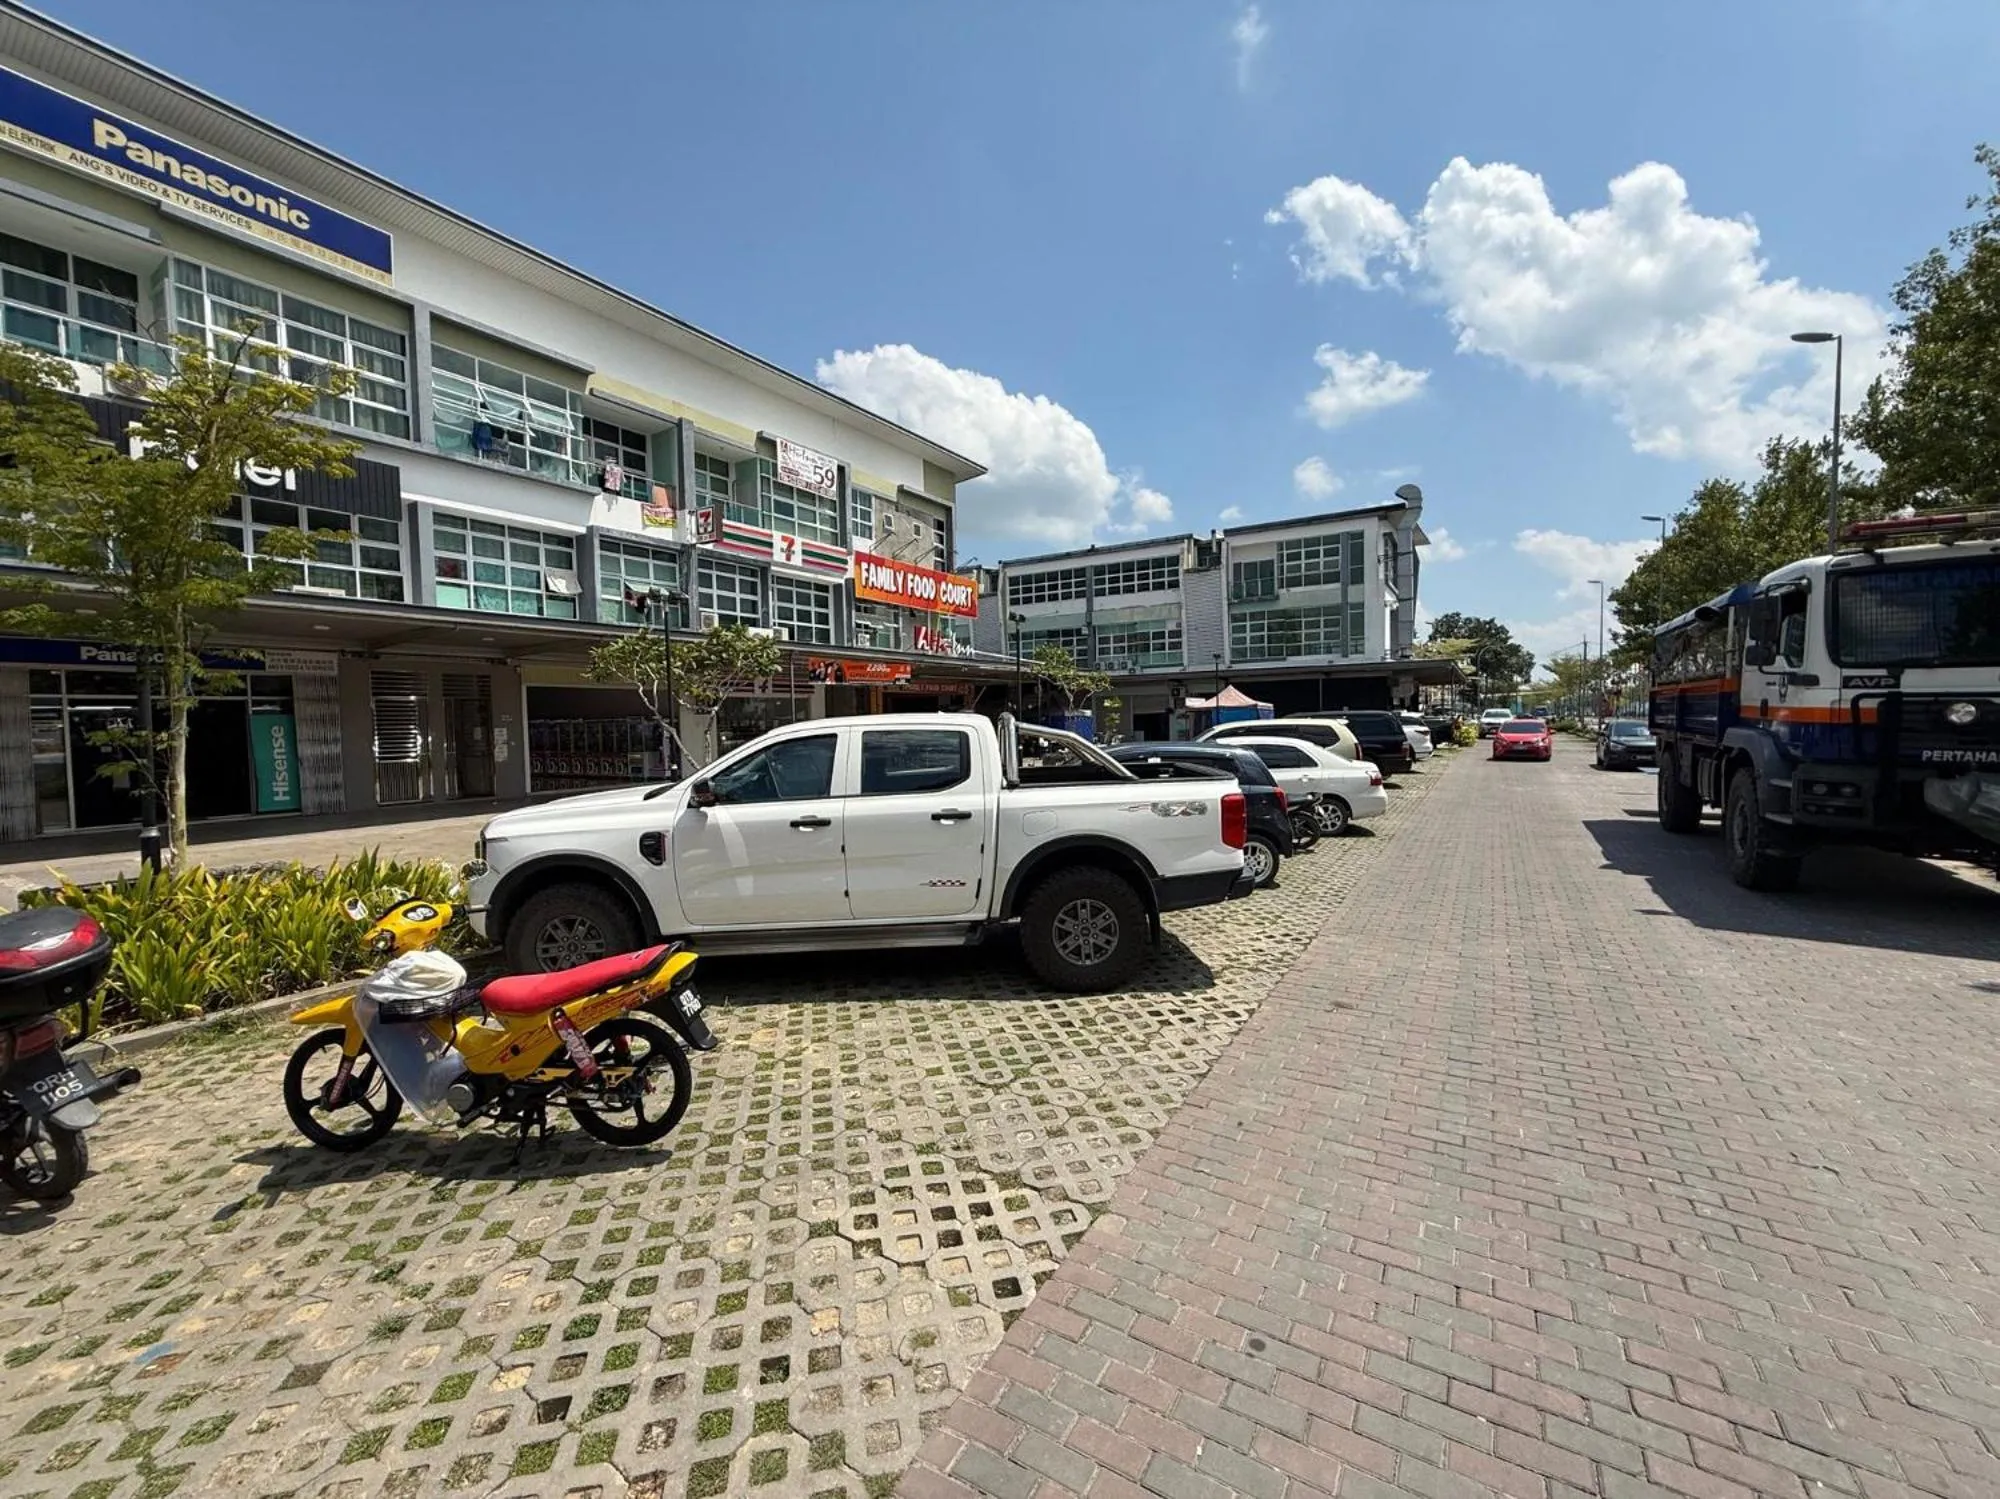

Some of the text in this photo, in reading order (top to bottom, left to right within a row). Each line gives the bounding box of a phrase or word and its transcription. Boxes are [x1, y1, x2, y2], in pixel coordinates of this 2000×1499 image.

[69, 152, 253, 230] ANG'S VIDEO & TV SERVICES
[92, 118, 310, 231] Panasonic
[813, 465, 835, 488] 59
[861, 561, 973, 608] FAMILY FOOD COURT
[1849, 677, 1896, 688] AVP
[271, 725, 291, 801] Hisense
[1921, 749, 2000, 762] PERTAHA
[41, 1078, 84, 1106] 1105
